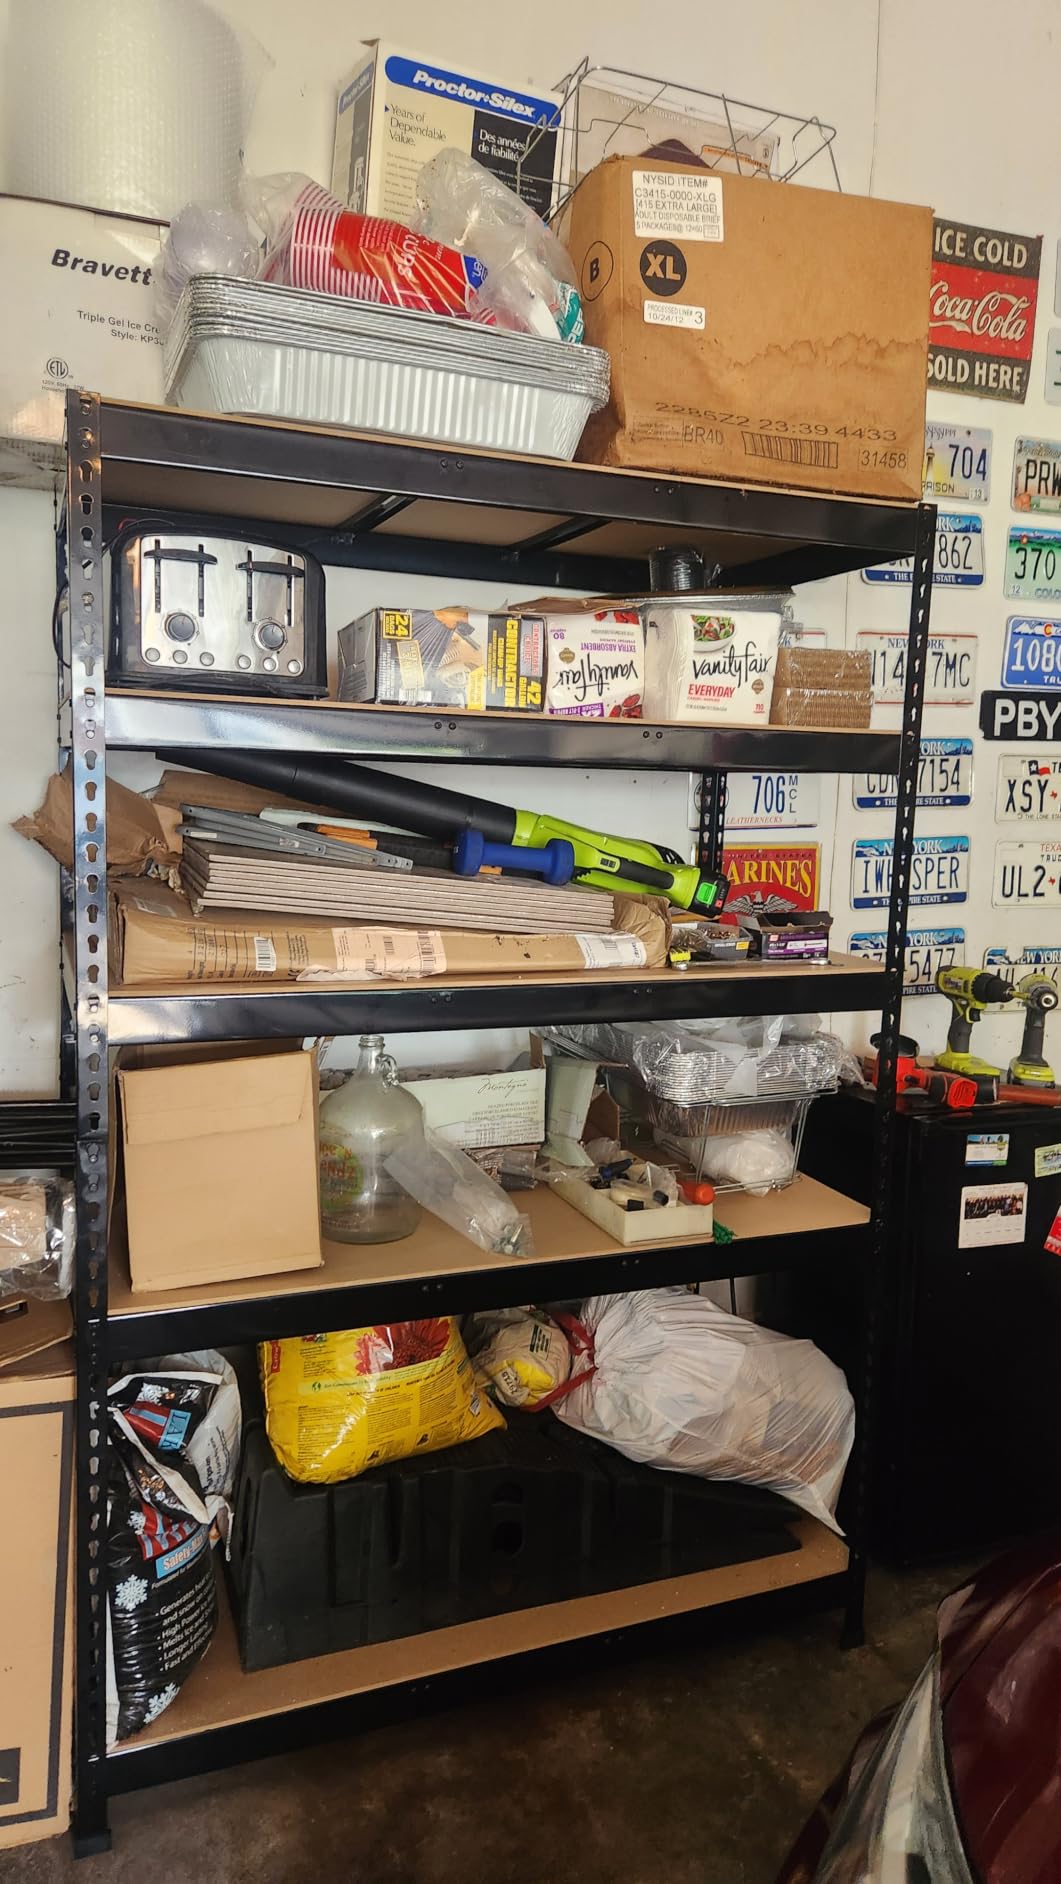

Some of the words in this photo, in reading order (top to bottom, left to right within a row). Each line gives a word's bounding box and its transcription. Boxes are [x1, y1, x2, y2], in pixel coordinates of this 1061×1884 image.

[390, 104, 413, 121] Years
[415, 112, 428, 123] of
[389, 131, 416, 147] Value.
[390, 118, 447, 142] Dependable
[480, 129, 496, 144] Des
[478, 142, 490, 154] de
[642, 173, 675, 186] NYSID
[678, 176, 708, 188] ITEM#
[656, 201, 684, 211] EXTRA
[934, 226, 967, 258] ICE
[973, 236, 1028, 269] COLD
[51, 248, 153, 286] Bravett
[590, 257, 600, 283] B
[645, 253, 681, 281] XL
[77, 310, 105, 324] Triple
[108, 316, 125, 328] Gel
[128, 320, 142, 331] Ice
[144, 323, 161, 334] Cre
[694, 311, 703, 325] 3
[111, 329, 138, 343] Style:
[974, 361, 1023, 392] HERE
[683, 424, 724, 446] BR40
[759, 418, 829, 437] 23:39
[836, 425, 898, 442] 4433
[860, 450, 908, 469] 31458
[949, 444, 987, 481] 704
[939, 534, 973, 570] 862
[1015, 547, 1056, 581] 370
[894, 573, 909, 581] THE
[935, 575, 957, 583] STATE
[395, 614, 409, 637] 24
[580, 642, 617, 651] ABSORBENT
[618, 644, 636, 653] EXTRA
[927, 639, 945, 649] ORK
[527, 680, 542, 705] 42
[688, 683, 736, 699] EVERYDAY
[993, 698, 1061, 740] PBY
[920, 741, 946, 756] ORK
[918, 758, 961, 793] 7154
[752, 775, 786, 814] 706
[924, 797, 944, 805] STATE
[1005, 779, 1049, 813] XSY
[726, 816, 783, 825] LEATHERNECKS
[913, 839, 943, 854] YORK
[1040, 843, 1061, 853] TEXA
[727, 859, 813, 898] ARINES
[863, 856, 960, 893] IWHSPER
[1001, 864, 1046, 898] UL2
[922, 895, 942, 903] STATE
[909, 931, 939, 946] YORK
[1020, 950, 1037, 964] EW
[1040, 950, 1061, 964] YOR
[902, 987, 917, 995] PIRE
[160, 1588, 195, 1616] Generates
[162, 1614, 178, 1626] and
[162, 1622, 182, 1640] High
[163, 1633, 184, 1650] Melts
[164, 1641, 189, 1660] Longer
[165, 1656, 181, 1672] Fast
